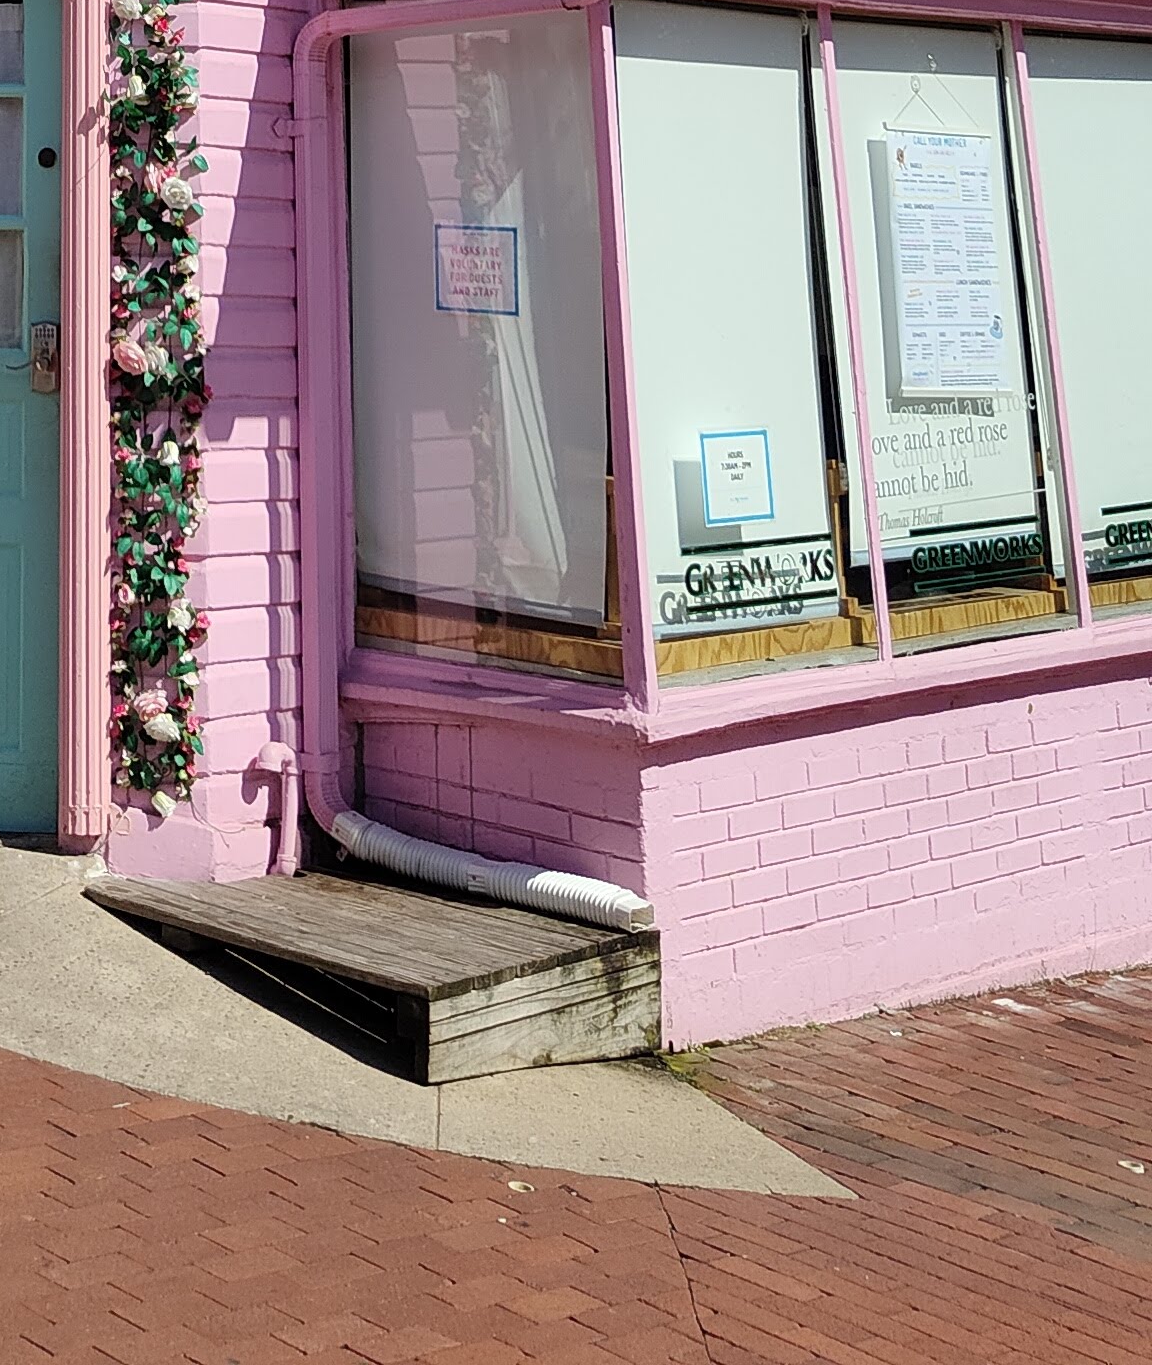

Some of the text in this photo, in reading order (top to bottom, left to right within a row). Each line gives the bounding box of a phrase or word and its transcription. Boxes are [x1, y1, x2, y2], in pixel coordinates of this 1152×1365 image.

[482, 247, 500, 257] ARE
[450, 272, 468, 282] FOR
[453, 285, 499, 298] AND STAFF
[871, 417, 1009, 456] ove and a red rose
[727, 450, 744, 459] HOURS
[730, 473, 744, 481] DAILY
[874, 459, 974, 499] annot be hid.
[912, 533, 1044, 574] GREENWORKS
